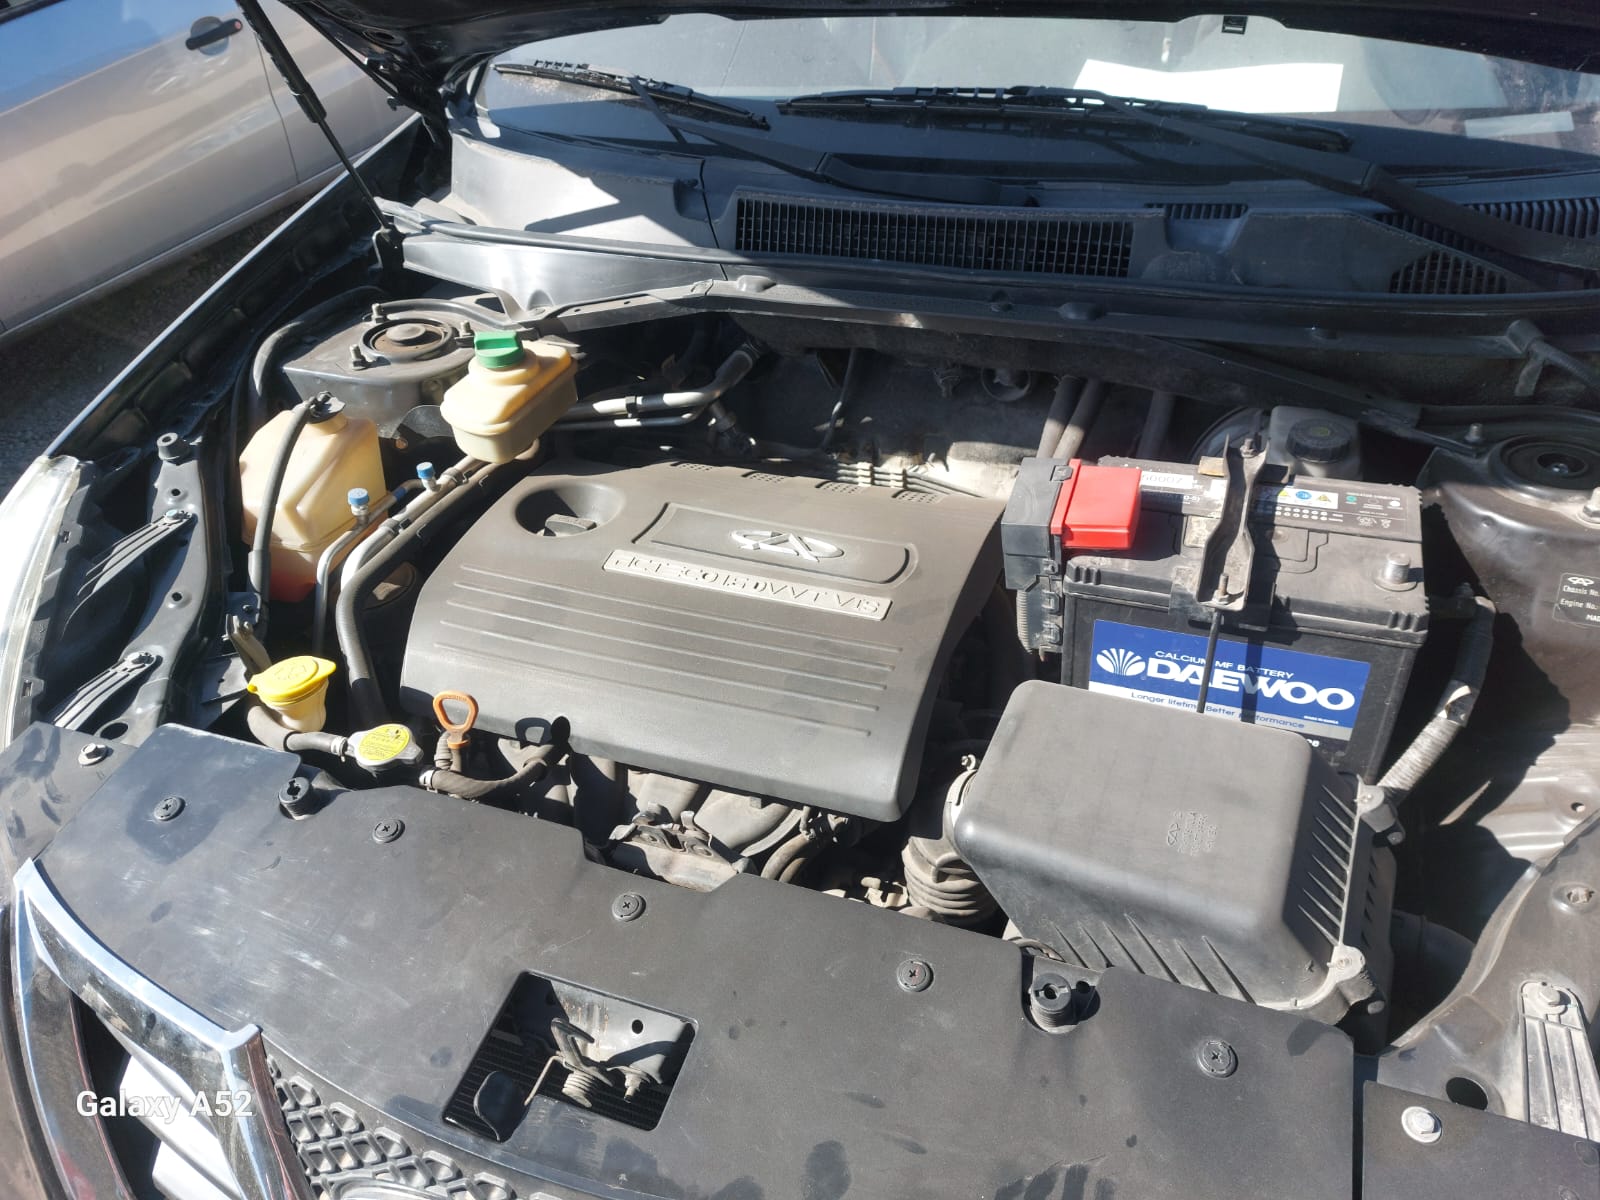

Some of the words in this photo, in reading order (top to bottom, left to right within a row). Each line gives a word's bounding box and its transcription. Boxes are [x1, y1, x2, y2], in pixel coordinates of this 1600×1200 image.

[1560, 598, 1583, 608] Engine
[1215, 661, 1233, 669] MF
[1237, 664, 1294, 679] BATTERY
[1147, 657, 1355, 710] DAEWOO
[1131, 692, 1164, 703] Longer
[1206, 705, 1236, 716] Better
